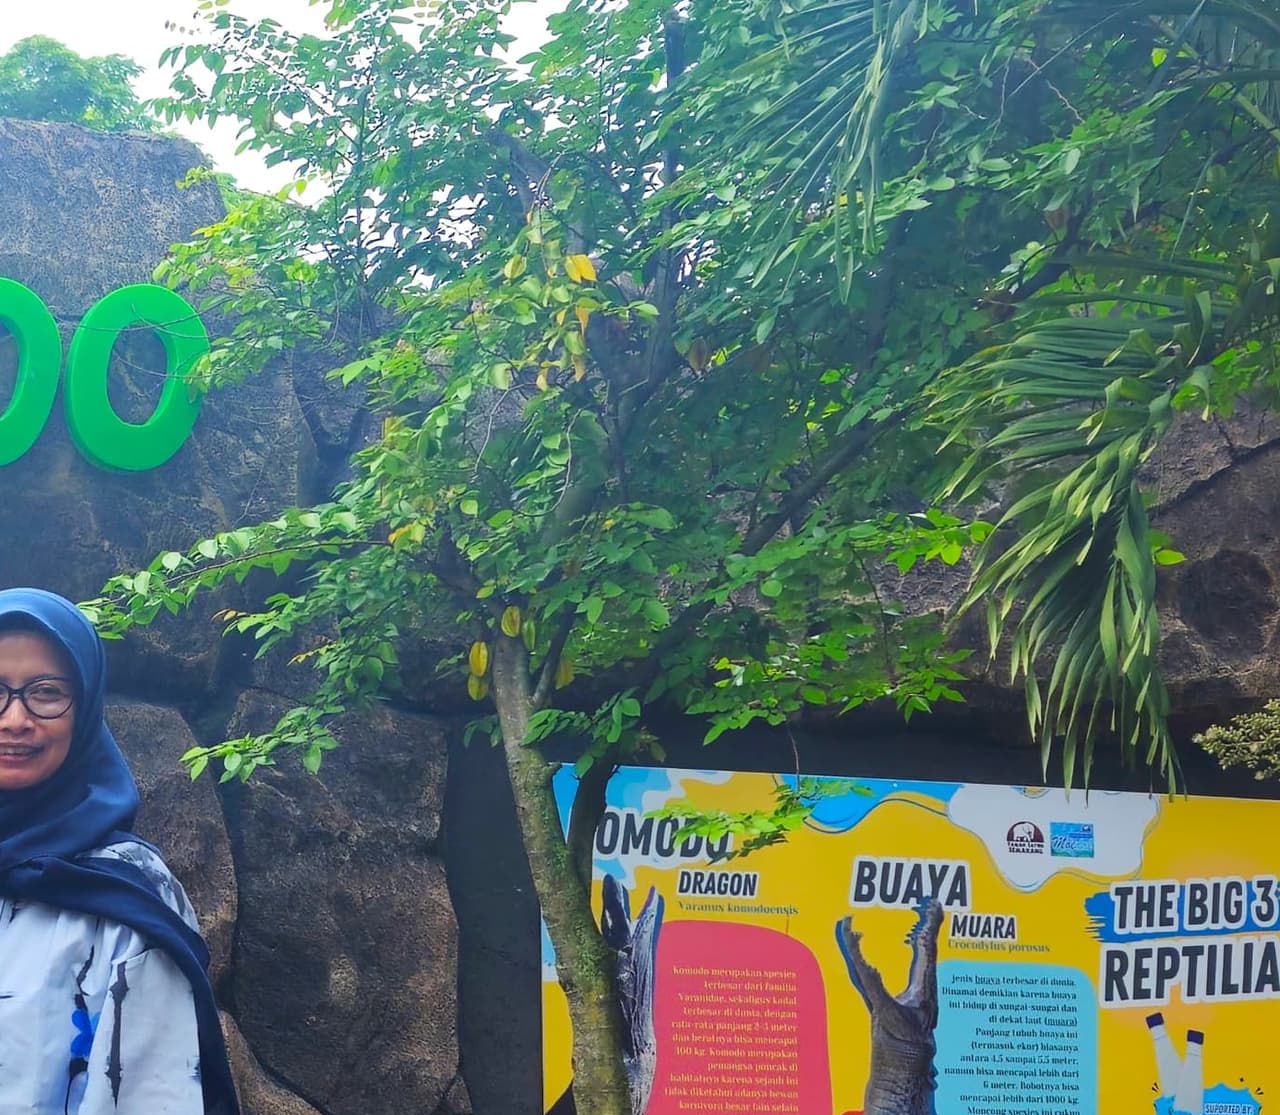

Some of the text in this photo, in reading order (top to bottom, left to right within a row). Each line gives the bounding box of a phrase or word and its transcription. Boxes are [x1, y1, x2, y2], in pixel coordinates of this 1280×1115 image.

[678, 870, 757, 897] DRAGON
[853, 860, 968, 907] BUAYA
[679, 900, 799, 916] Varanus komodoensis
[1114, 879, 1275, 930] THE BIG 3
[950, 914, 1017, 940] MUARA
[947, 938, 1051, 954] Crocodylus porosus
[1104, 941, 1280, 1002] REPTILIA
[1046, 1095, 1066, 1104] 1000
